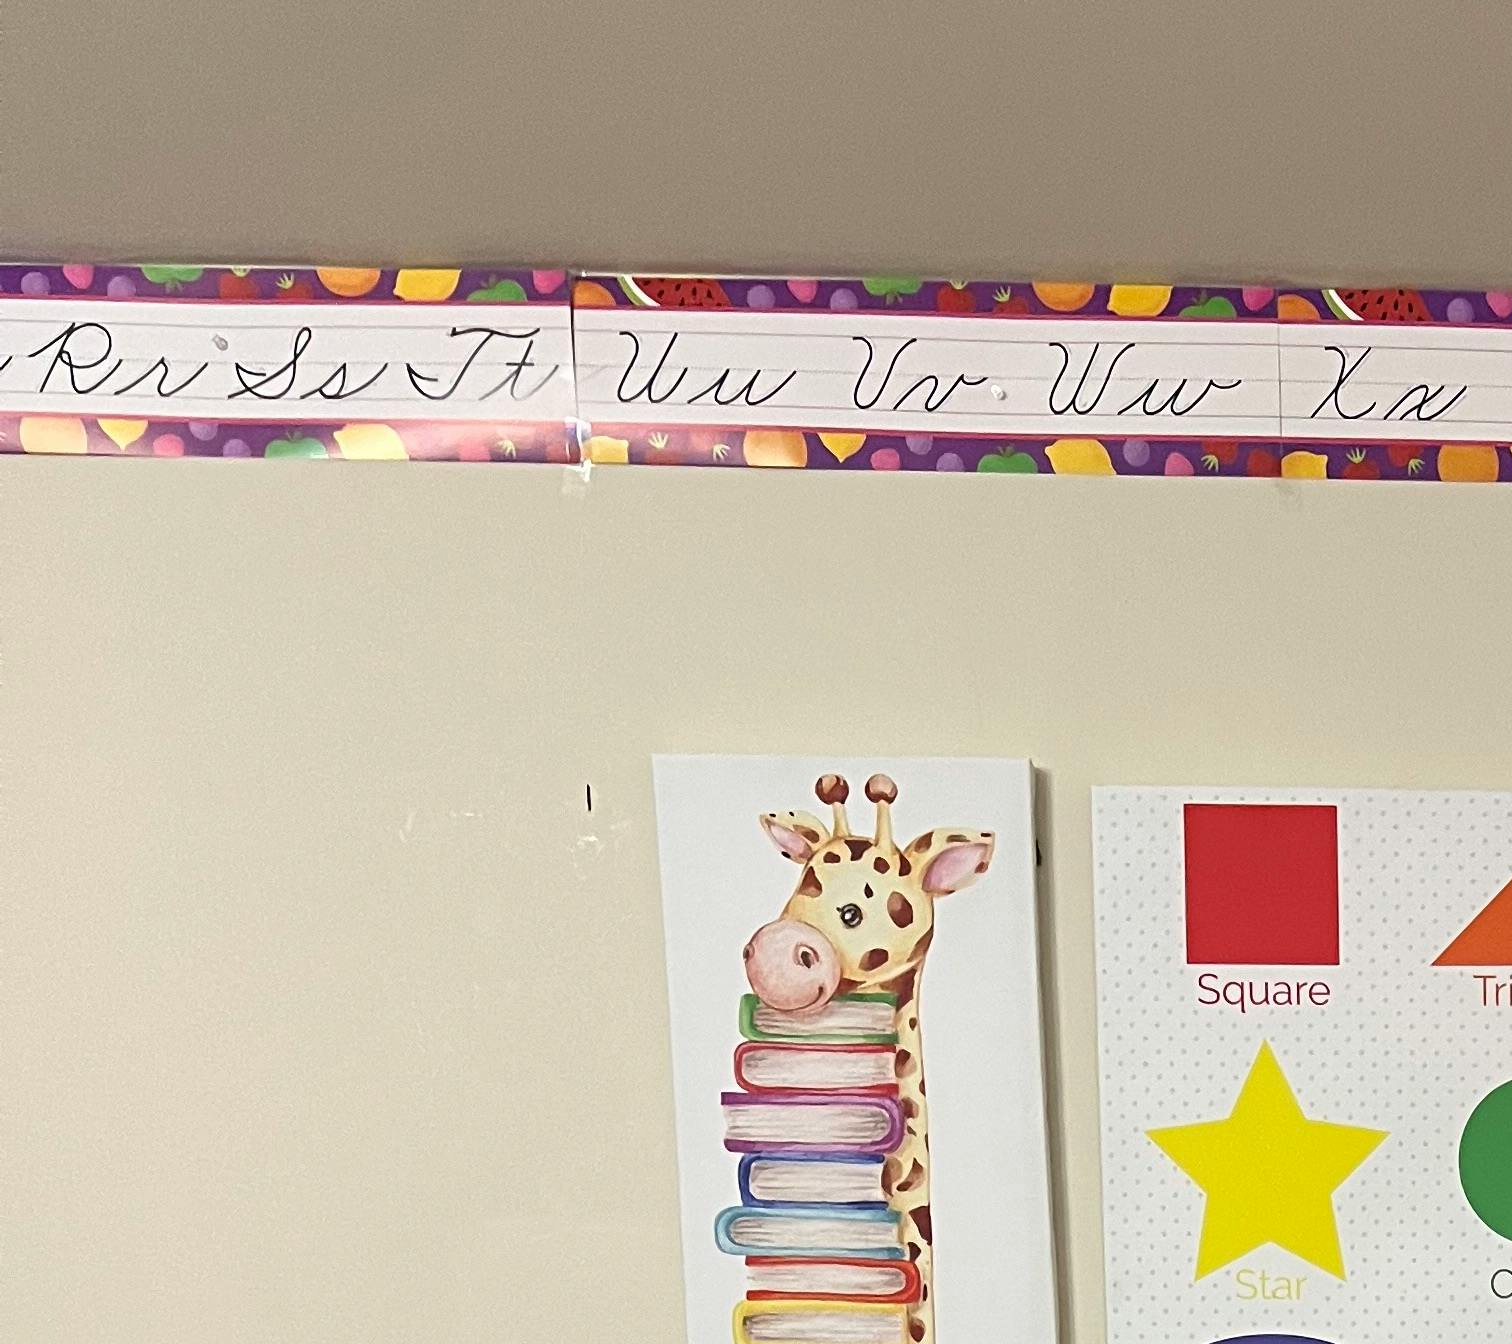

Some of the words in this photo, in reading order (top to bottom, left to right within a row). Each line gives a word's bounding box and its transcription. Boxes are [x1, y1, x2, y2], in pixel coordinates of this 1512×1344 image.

[28, 322, 208, 398] Rr
[228, 327, 389, 400] Ss
[407, 327, 560, 401] Tt
[618, 331, 797, 405] Uu
[852, 336, 988, 412] Vv
[1049, 342, 1241, 416] Ww
[1311, 346, 1467, 421] Xx
[1197, 973, 1331, 1013] Square
[1235, 1269, 1308, 1301] Star
